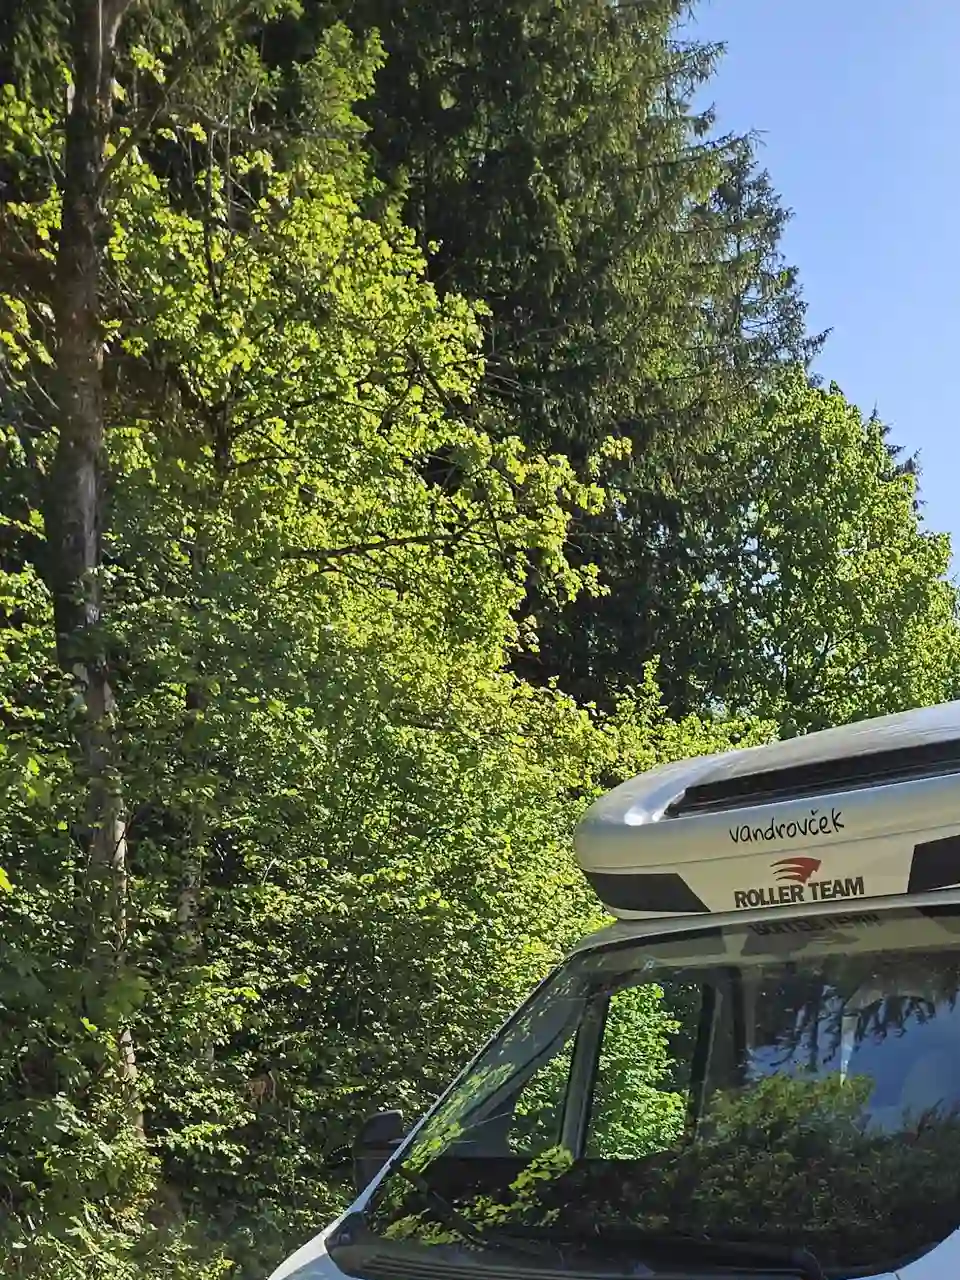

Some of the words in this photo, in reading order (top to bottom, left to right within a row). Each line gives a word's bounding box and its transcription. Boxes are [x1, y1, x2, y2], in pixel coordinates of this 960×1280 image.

[729, 808, 845, 843] vandrovček
[734, 884, 804, 908] ROLLER
[808, 876, 865, 900] TEAM
